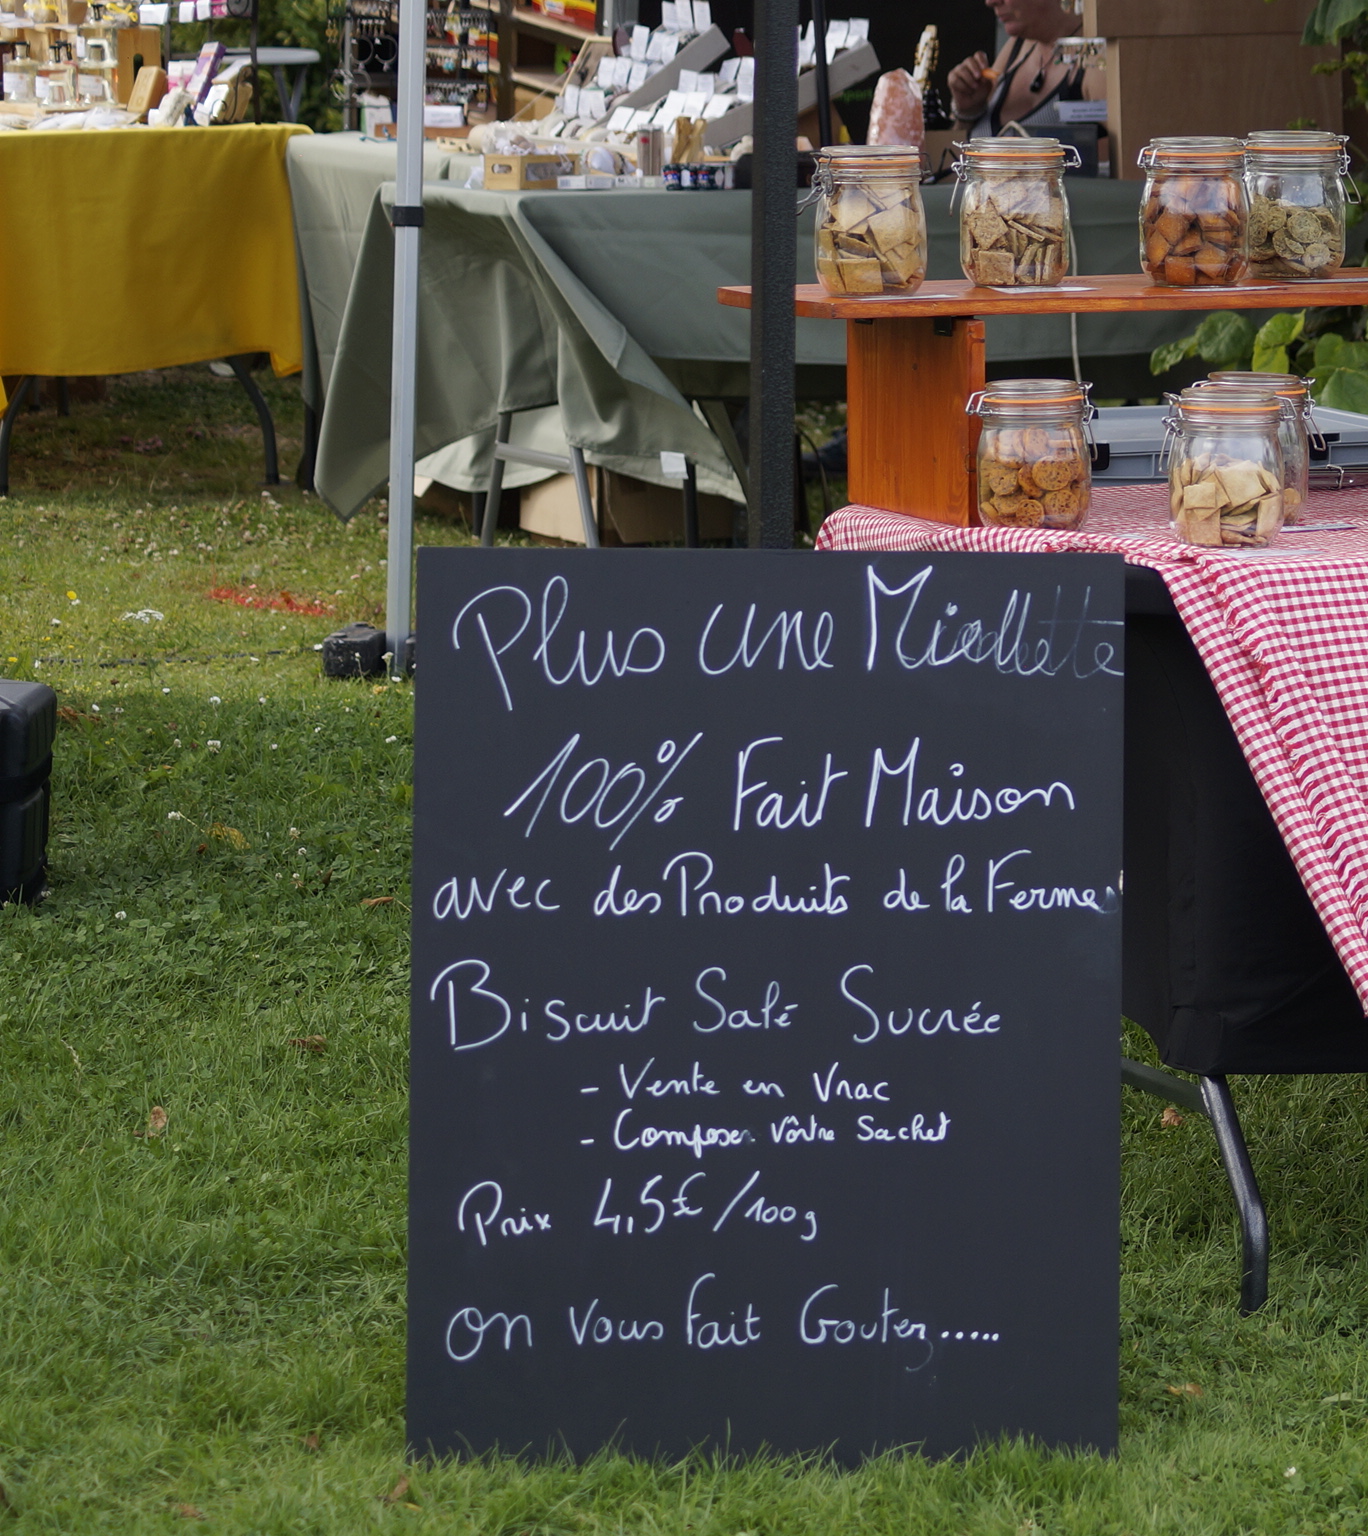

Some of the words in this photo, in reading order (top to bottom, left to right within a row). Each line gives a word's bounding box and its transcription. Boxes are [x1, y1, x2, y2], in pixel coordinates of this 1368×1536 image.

[452, 575, 665, 711] Plus
[503, 732, 703, 851] 100%
[733, 737, 848, 831] Fait
[865, 737, 1075, 828] Maison
[433, 868, 560, 920] avec
[593, 865, 661, 916] des
[662, 851, 850, 917] Produits
[883, 868, 930, 911] de
[940, 854, 972, 914] la
[430, 959, 666, 1051] Biscuit
[693, 967, 798, 1033] Salé
[840, 964, 1000, 1043] Sucrée
[619, 1057, 720, 1099] Vente
[742, 1080, 785, 1098] en
[812, 1062, 890, 1102] Vrac
[857, 1111, 951, 1142] Sachet
[457, 1181, 551, 1247] Prix
